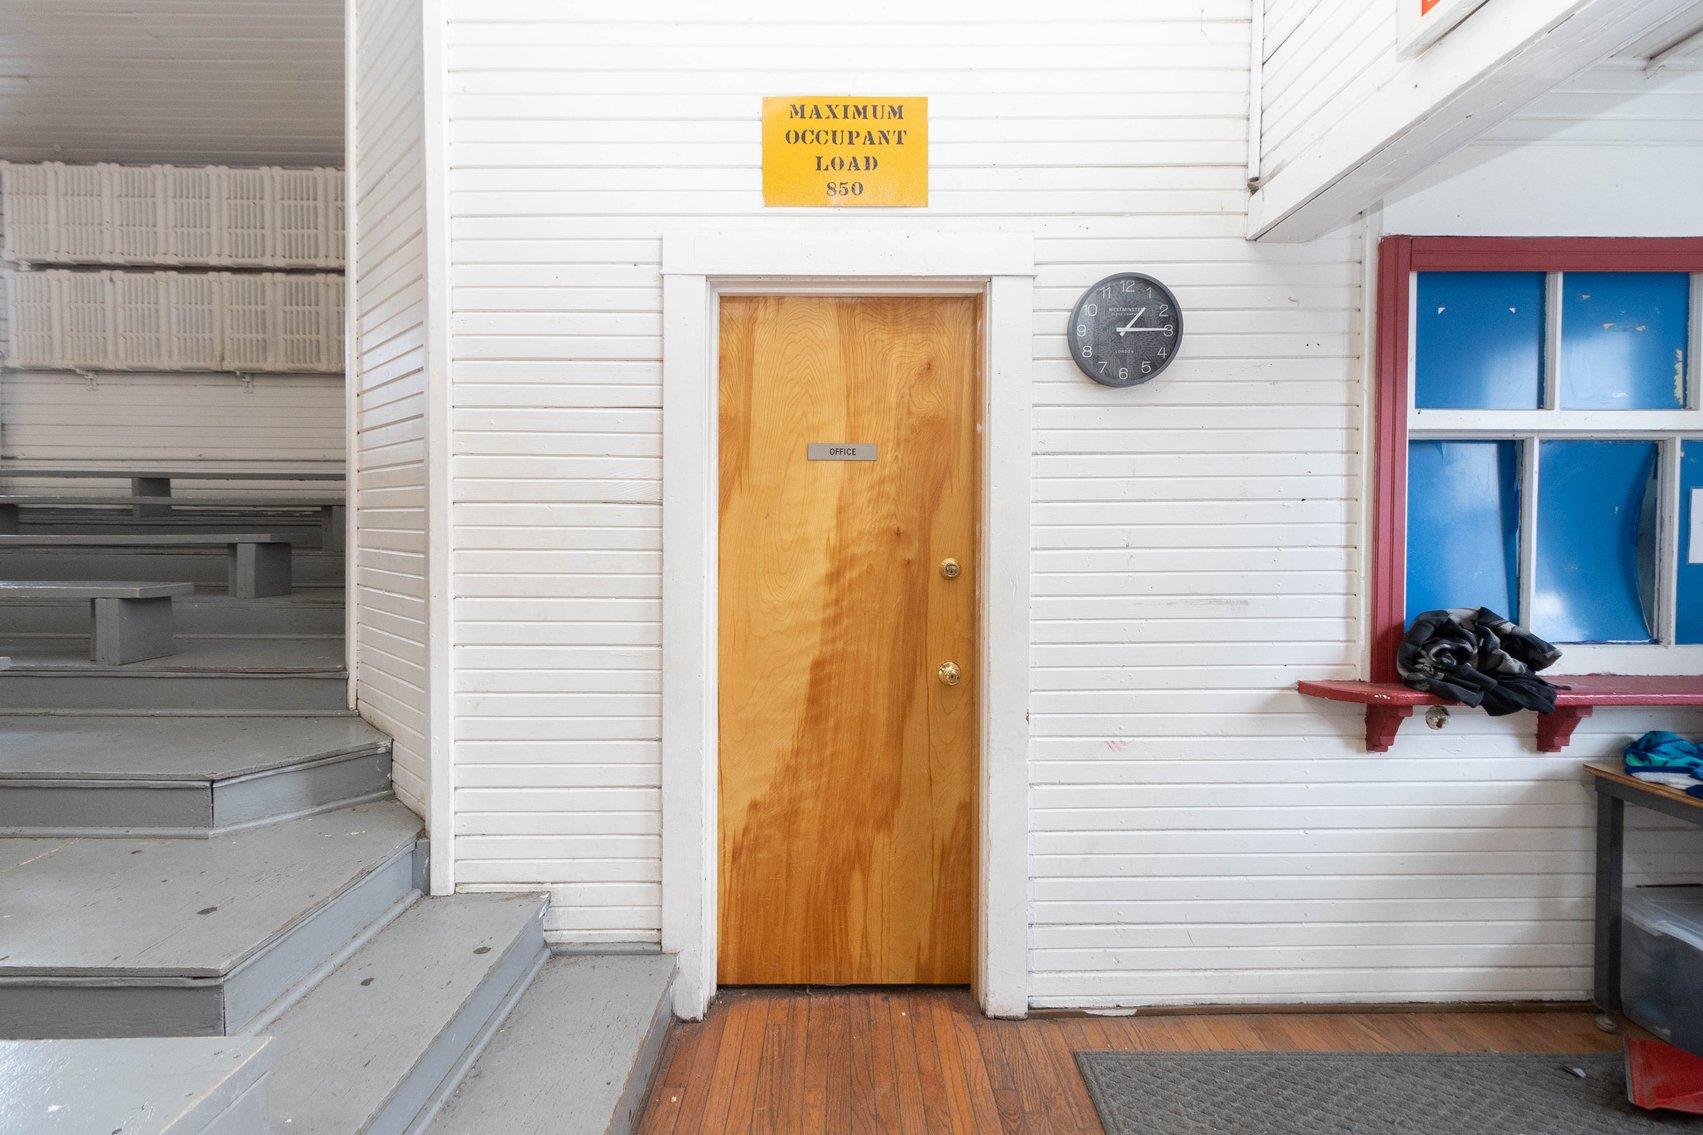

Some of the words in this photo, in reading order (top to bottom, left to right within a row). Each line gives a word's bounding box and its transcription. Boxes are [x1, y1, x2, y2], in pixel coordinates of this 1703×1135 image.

[789, 104, 904, 120] MAXIMUM
[785, 129, 907, 145] OCCUPANT
[815, 155, 878, 172] LOAD
[826, 181, 864, 197] 850
[1100, 286, 1111, 299] 11
[1120, 280, 1136, 293] 12
[1146, 287, 1152, 299] 1
[1082, 303, 1098, 317] 10
[1159, 304, 1169, 317] 2
[1077, 324, 1087, 337] 9
[1163, 324, 1174, 337] 3
[1081, 345, 1093, 358] 8
[1157, 347, 1168, 359] 4
[1098, 361, 1108, 374] 7
[1118, 367, 1129, 380] 6
[1141, 361, 1152, 374] 5
[829, 447, 857, 456] OFFICE
